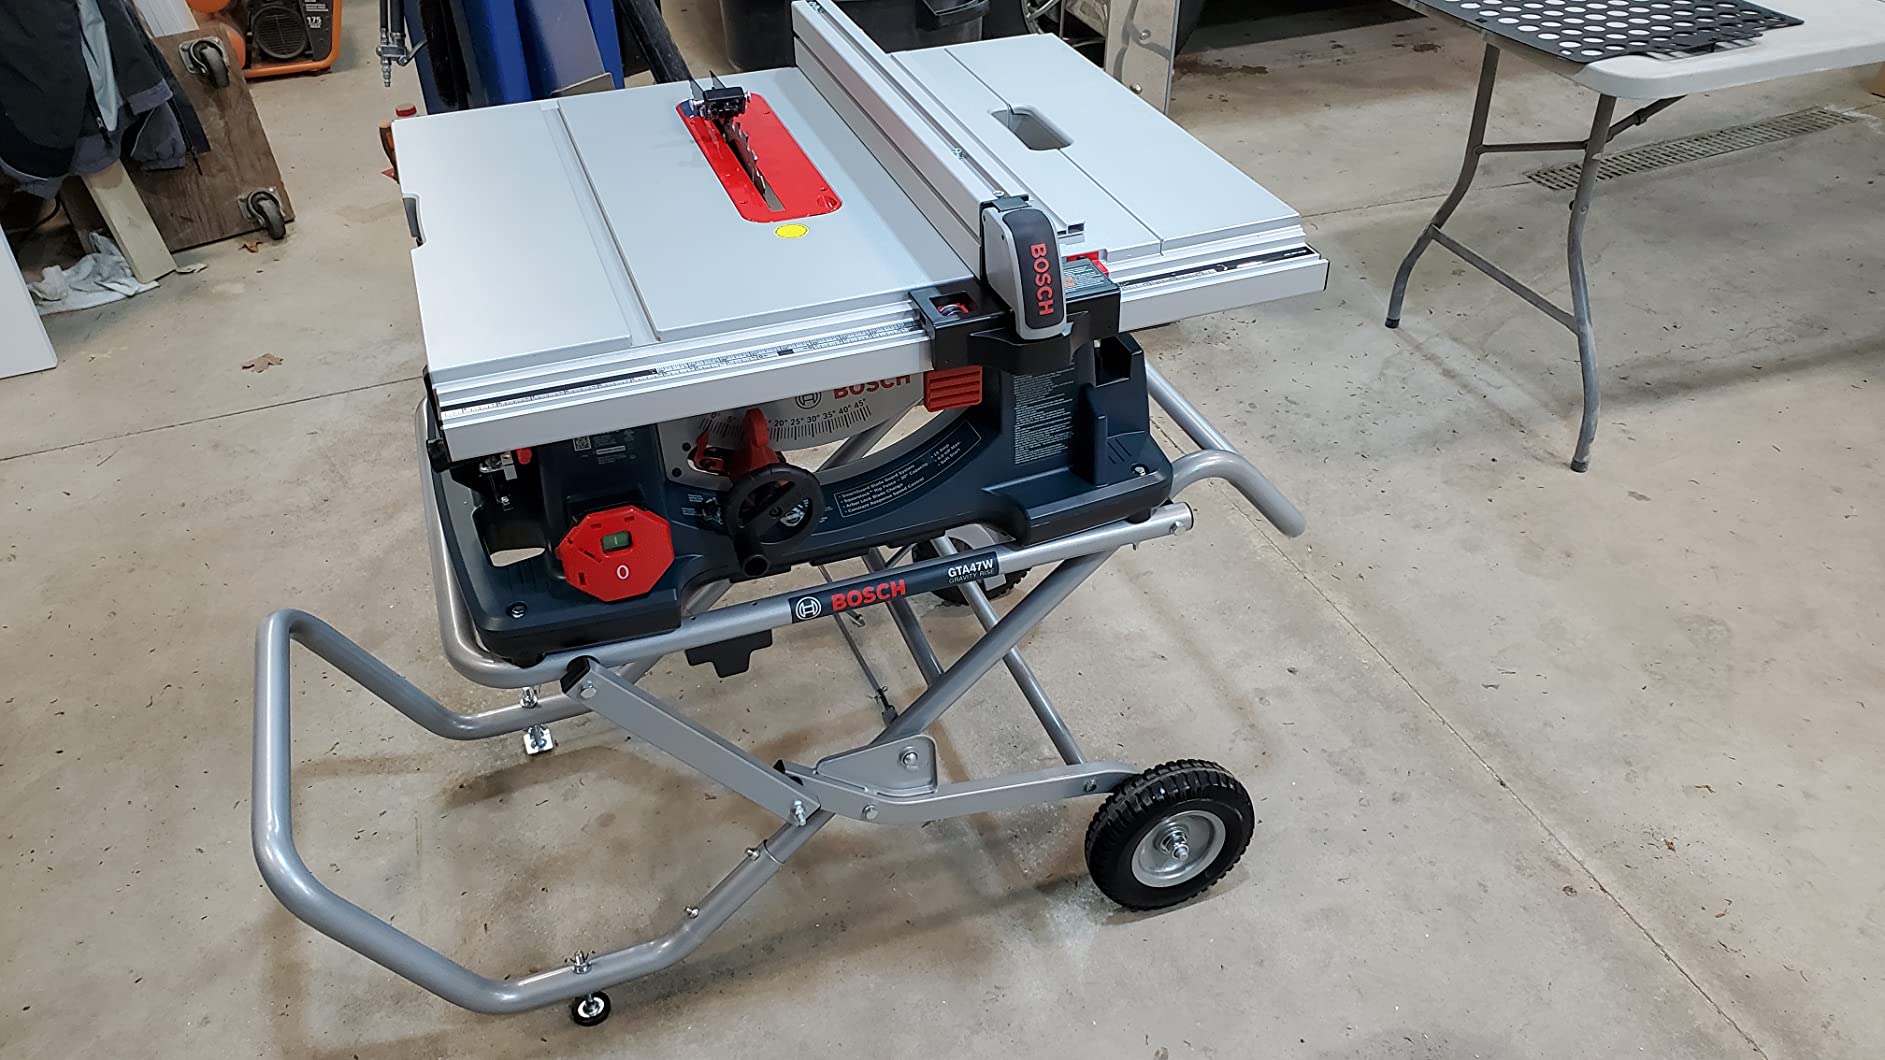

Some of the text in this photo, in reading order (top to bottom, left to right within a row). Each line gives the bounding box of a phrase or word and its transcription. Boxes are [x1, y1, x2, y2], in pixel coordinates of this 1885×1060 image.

[1030, 243, 1054, 315] BOSCH
[833, 374, 911, 399] BOSCH
[790, 417, 804, 426] 25°
[807, 414, 820, 423] 30°
[822, 410, 836, 420] 35°
[838, 404, 852, 415] 40°
[854, 398, 866, 408] 45°
[870, 480, 884, 488] Blade
[884, 473, 898, 482] Guard
[898, 464, 915, 476] System
[907, 476, 924, 489] Control
[872, 491, 886, 499] Blade
[886, 483, 903, 493] Change
[947, 558, 993, 578] GTA47W
[948, 572, 977, 584] GRAVITY
[832, 579, 906, 611] BOSCH
